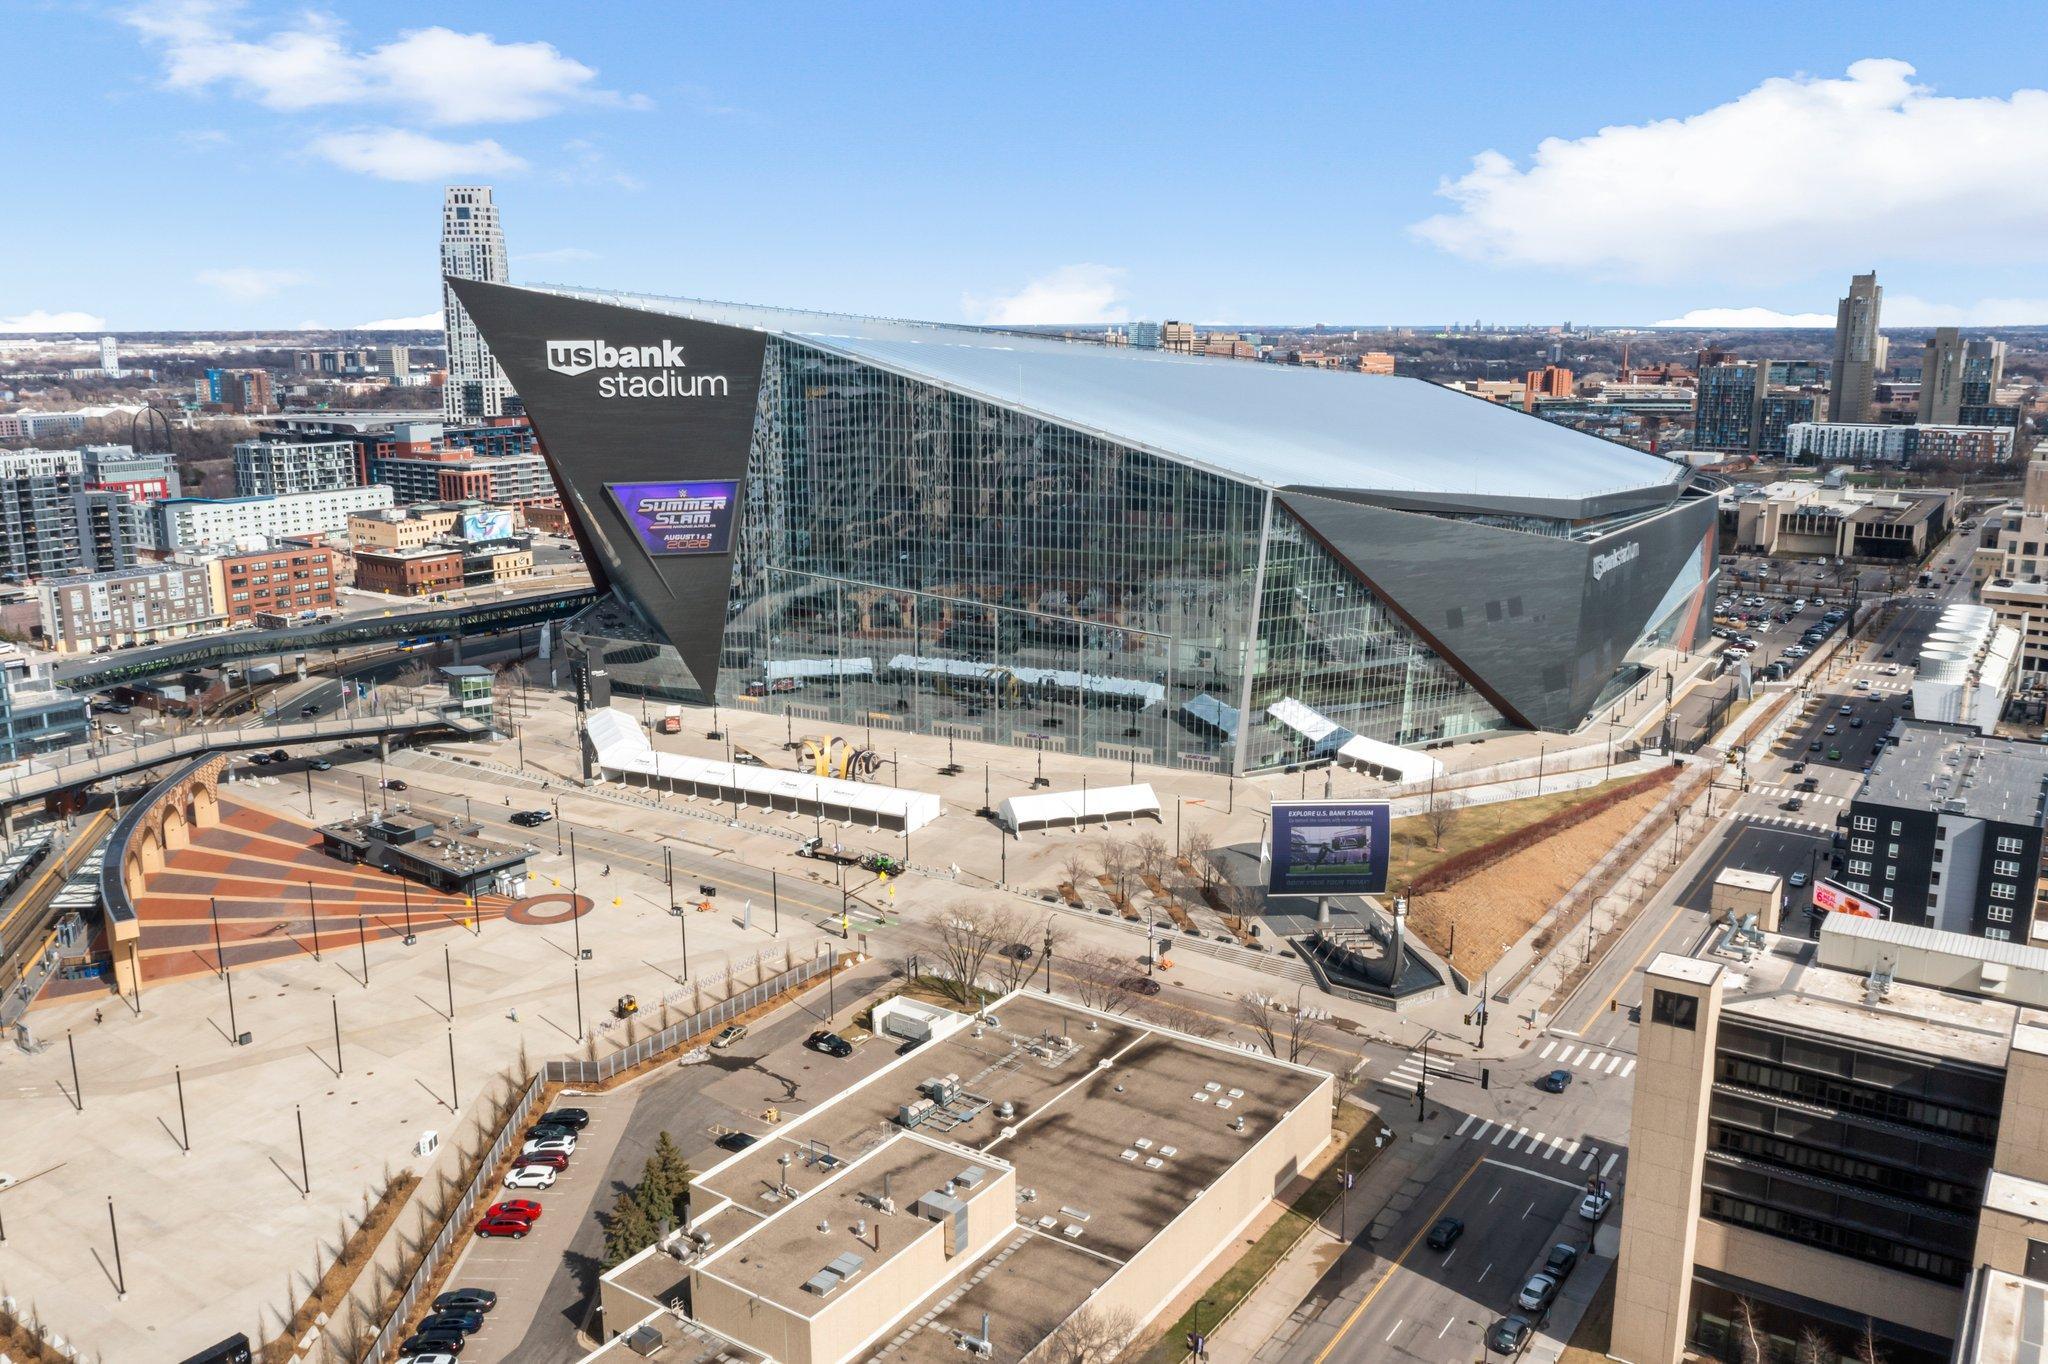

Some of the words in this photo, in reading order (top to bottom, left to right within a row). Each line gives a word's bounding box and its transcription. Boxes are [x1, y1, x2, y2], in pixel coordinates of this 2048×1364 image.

[599, 369, 728, 398] stadium
[638, 496, 727, 512] SUMMER
[653, 510, 711, 525] SLAM
[664, 533, 695, 541] AUGUST
[667, 540, 710, 549] 2026
